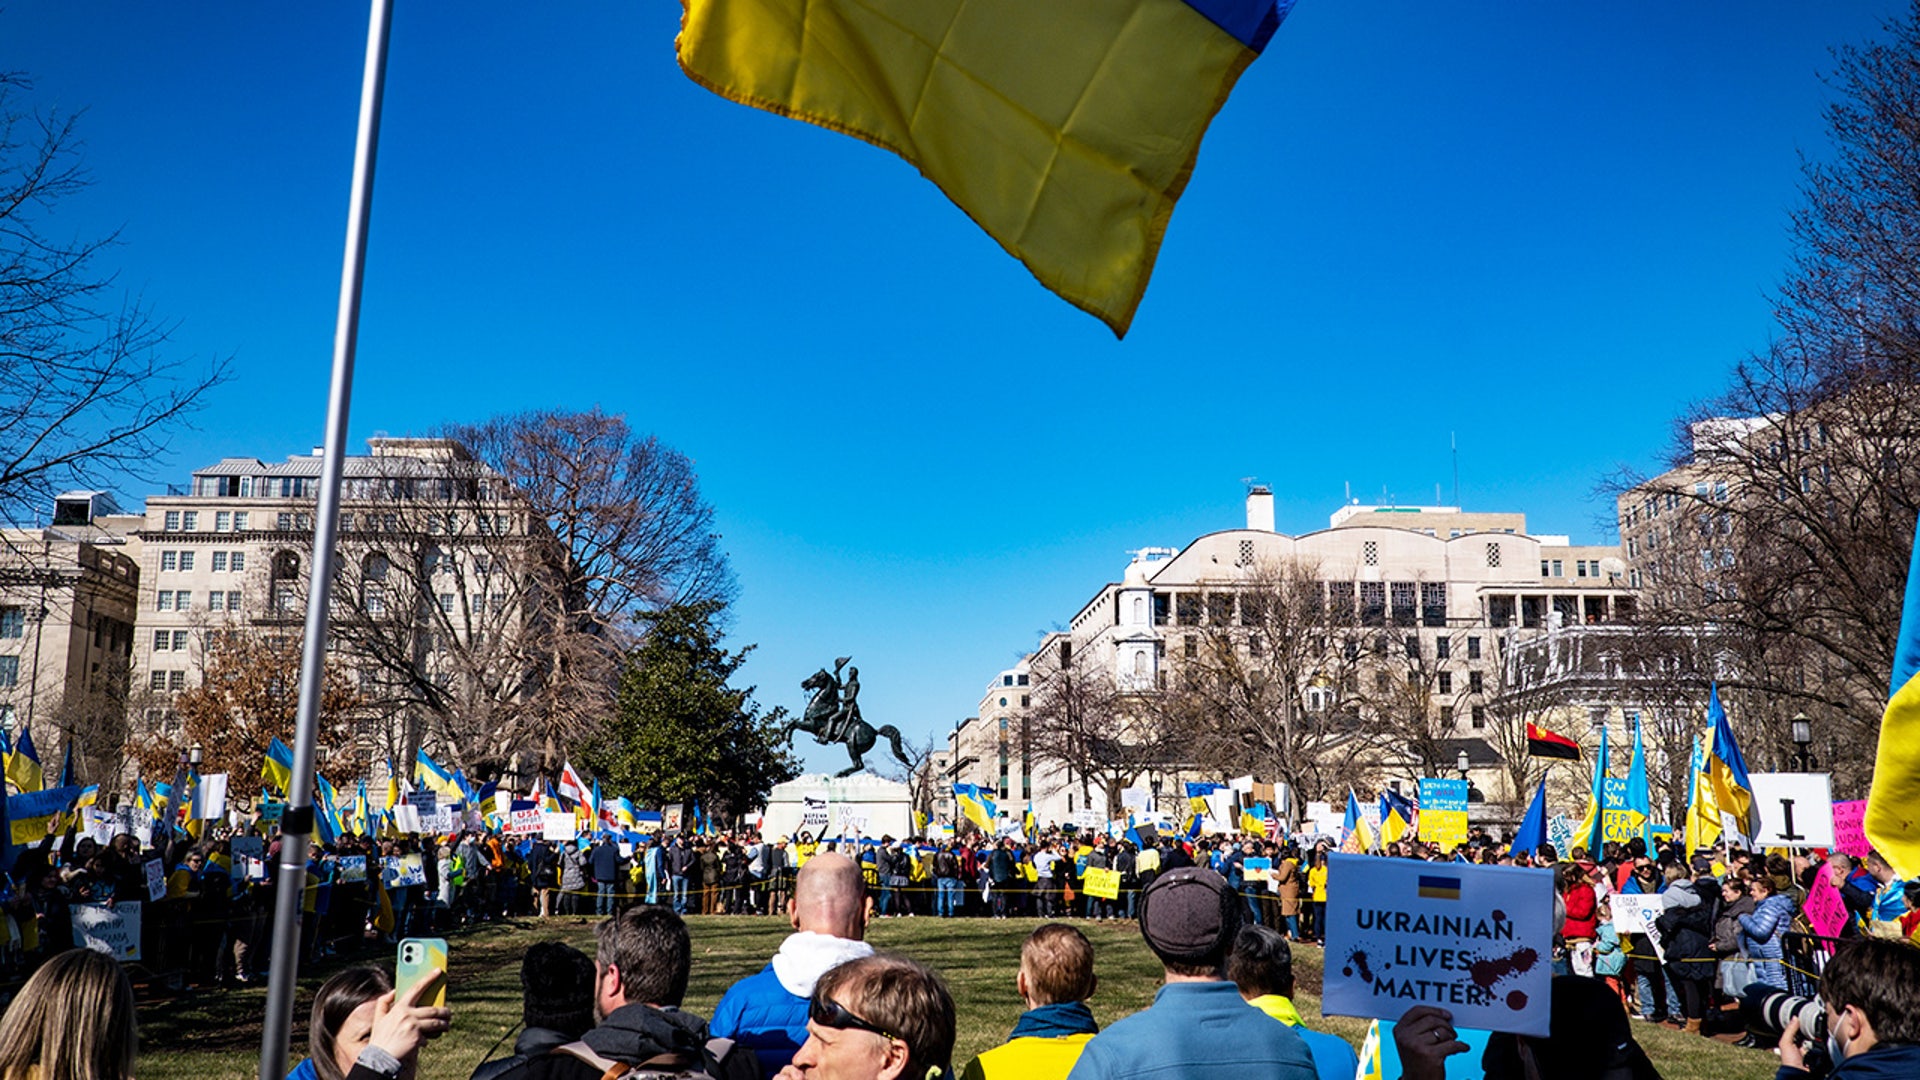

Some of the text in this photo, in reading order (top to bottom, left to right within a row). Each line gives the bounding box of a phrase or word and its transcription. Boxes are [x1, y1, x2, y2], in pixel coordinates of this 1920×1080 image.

[517, 808, 539, 819] USA
[1776, 798, 1805, 841] I
[1356, 908, 1514, 941] UKRAINIAN
[1394, 945, 1473, 972] LIVES
